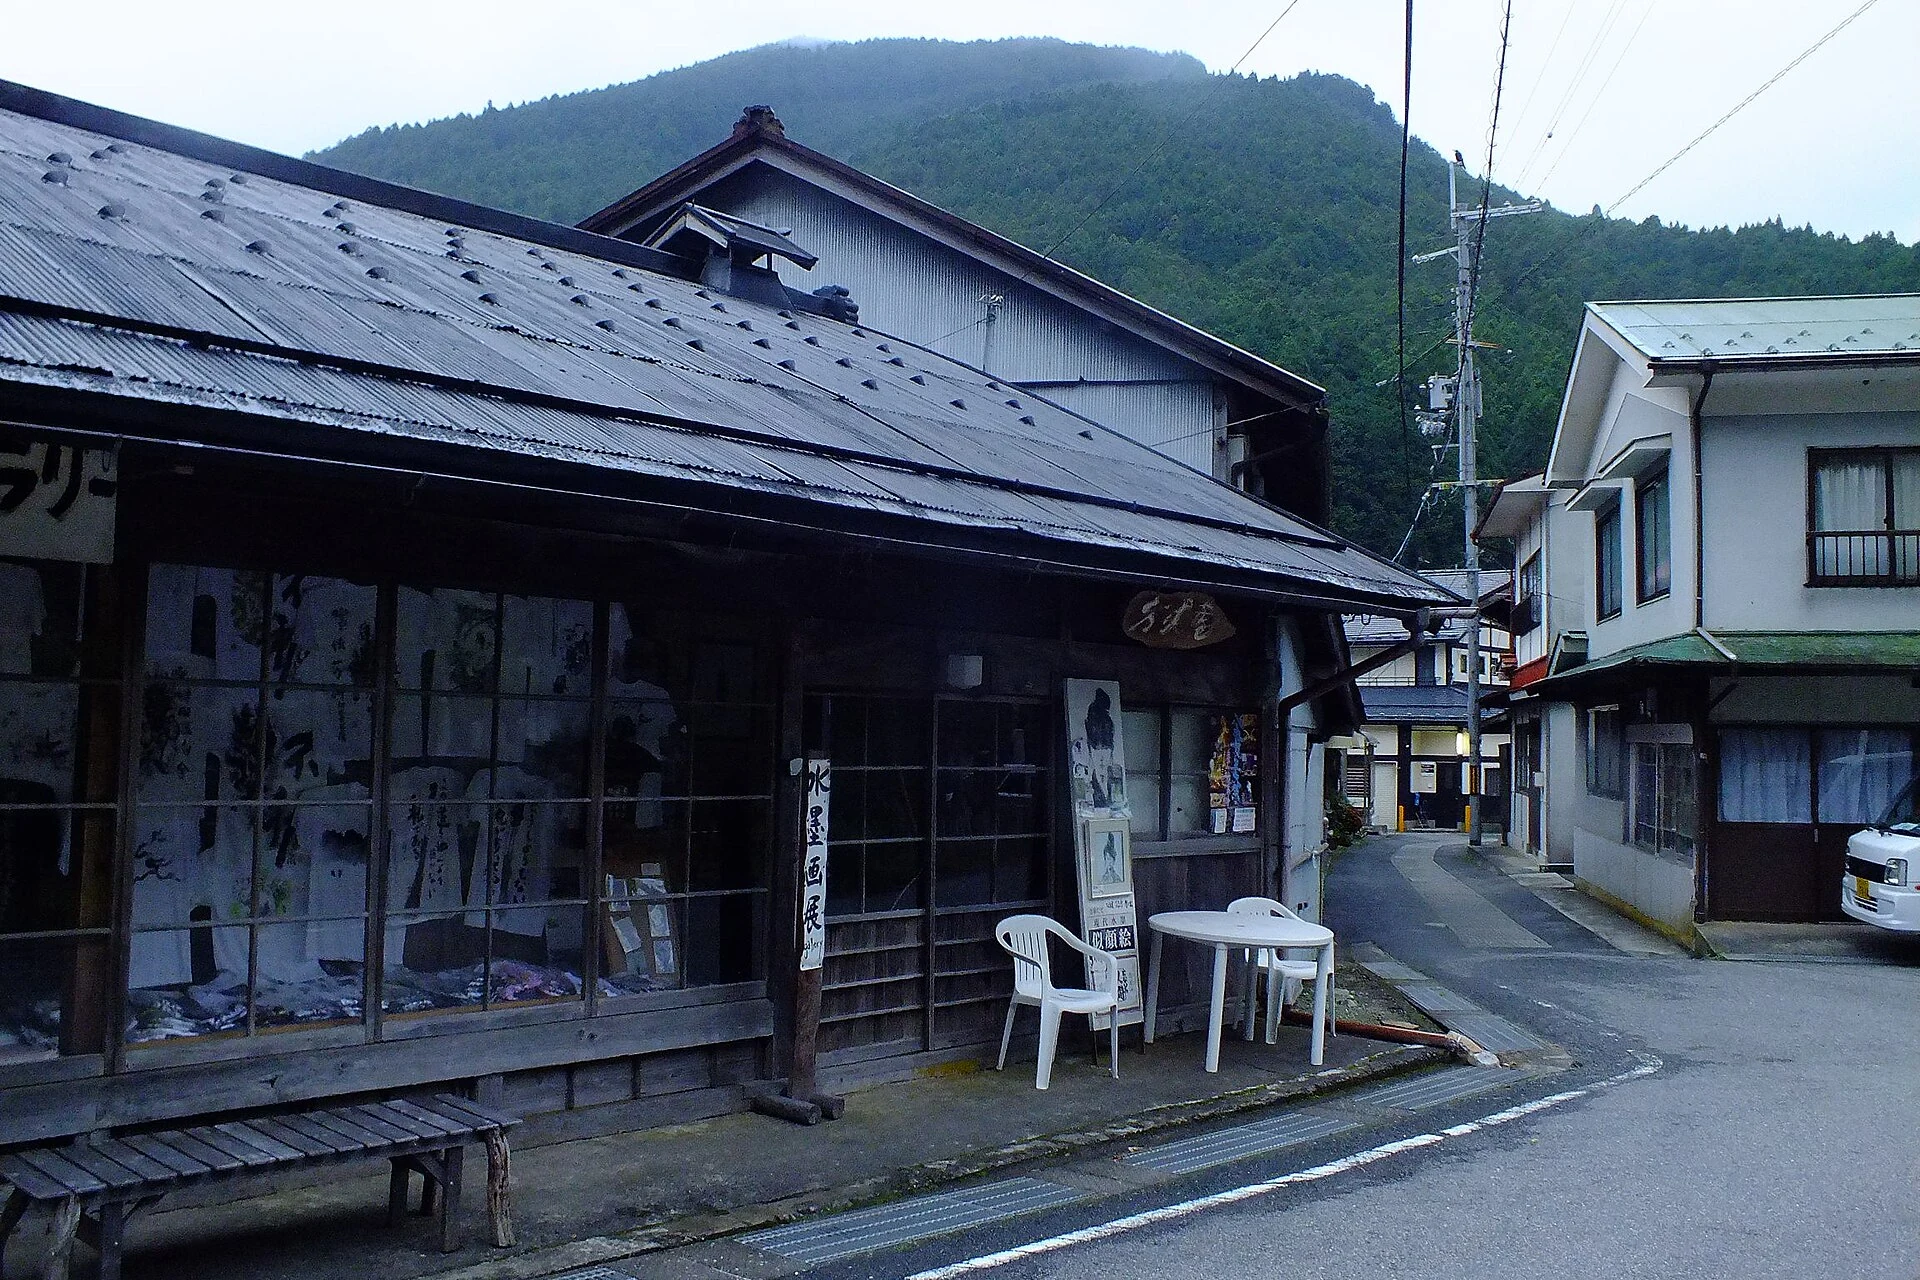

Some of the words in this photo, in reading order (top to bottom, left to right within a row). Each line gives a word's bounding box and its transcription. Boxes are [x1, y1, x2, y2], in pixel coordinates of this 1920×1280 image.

[803, 763, 830, 934] 水墨画展
[804, 938, 823, 960] gallery
[1092, 927, 1132, 949] 似顔絵
